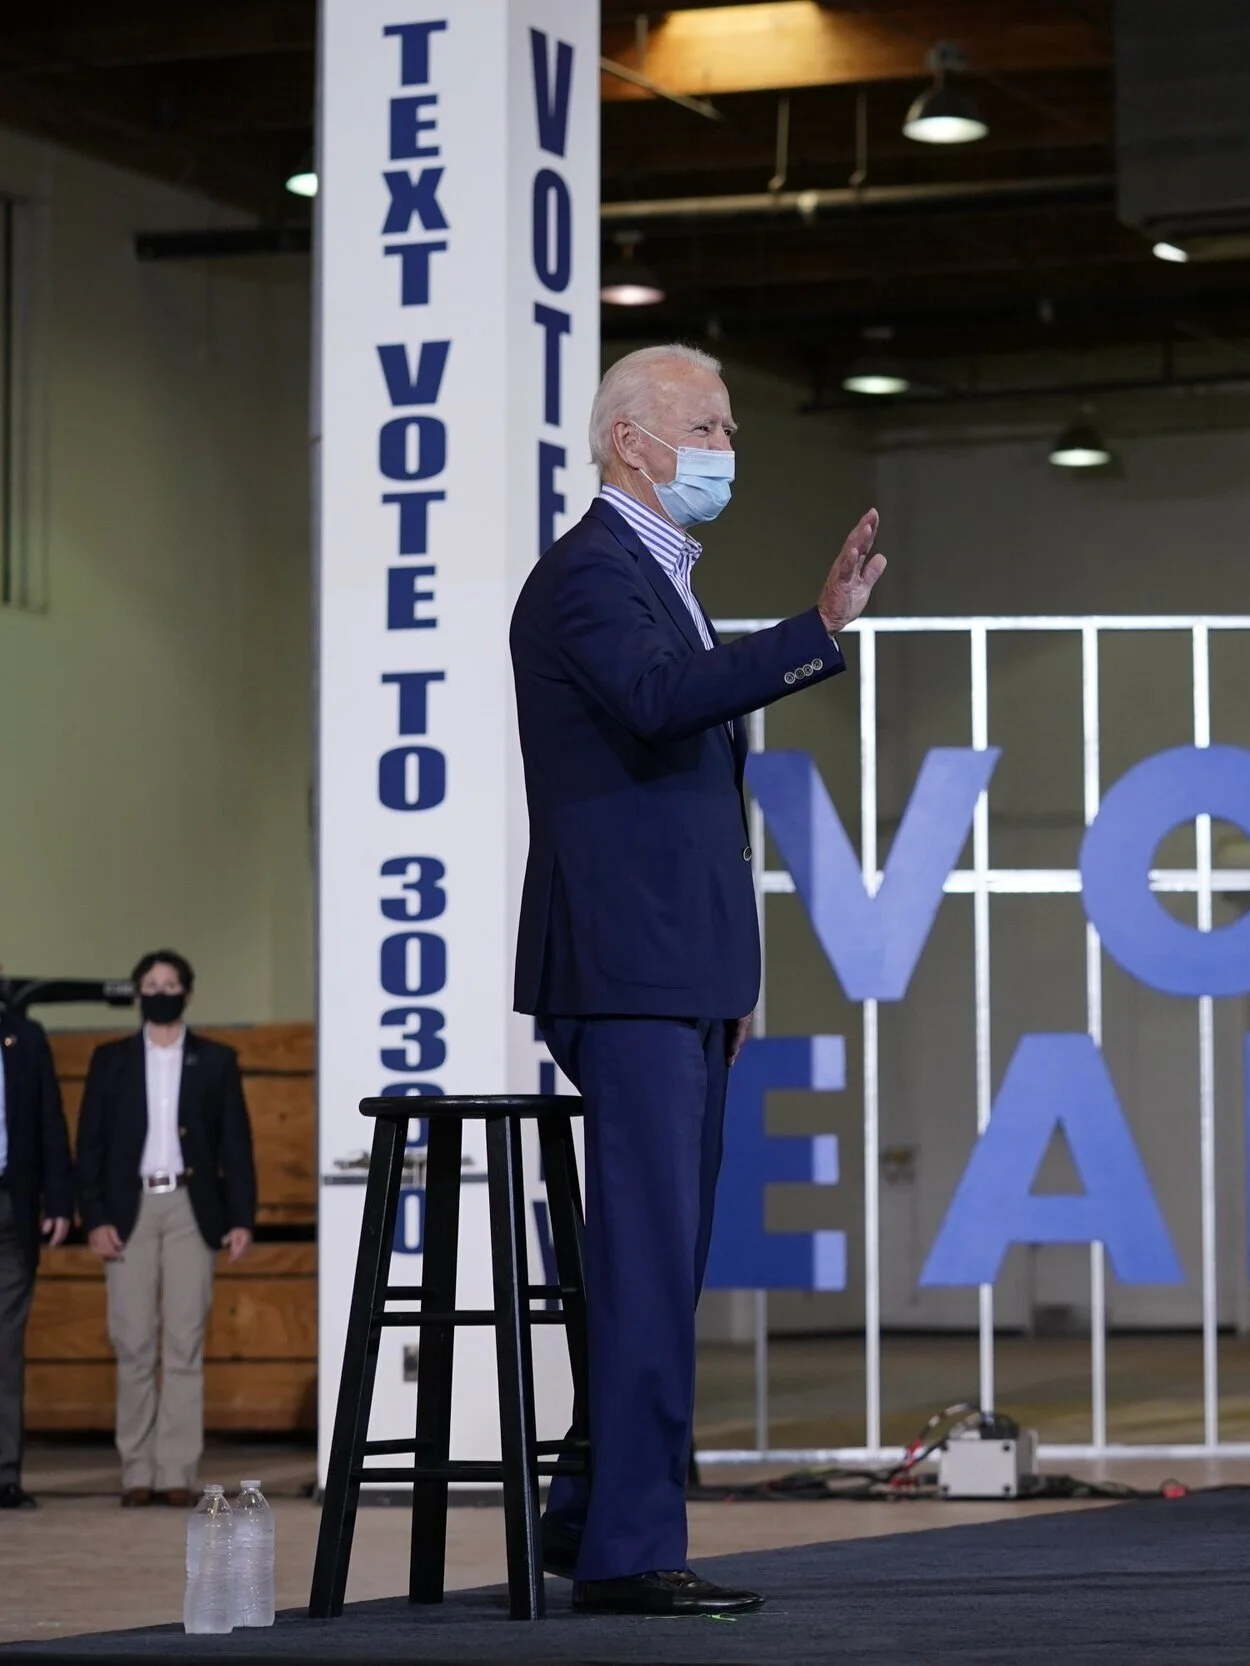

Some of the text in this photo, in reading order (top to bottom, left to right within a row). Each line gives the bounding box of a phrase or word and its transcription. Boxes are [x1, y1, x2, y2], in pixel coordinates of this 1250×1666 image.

[381, 20, 450, 306] TEXT
[376, 340, 452, 631] VOTE
[378, 670, 448, 812] TO
